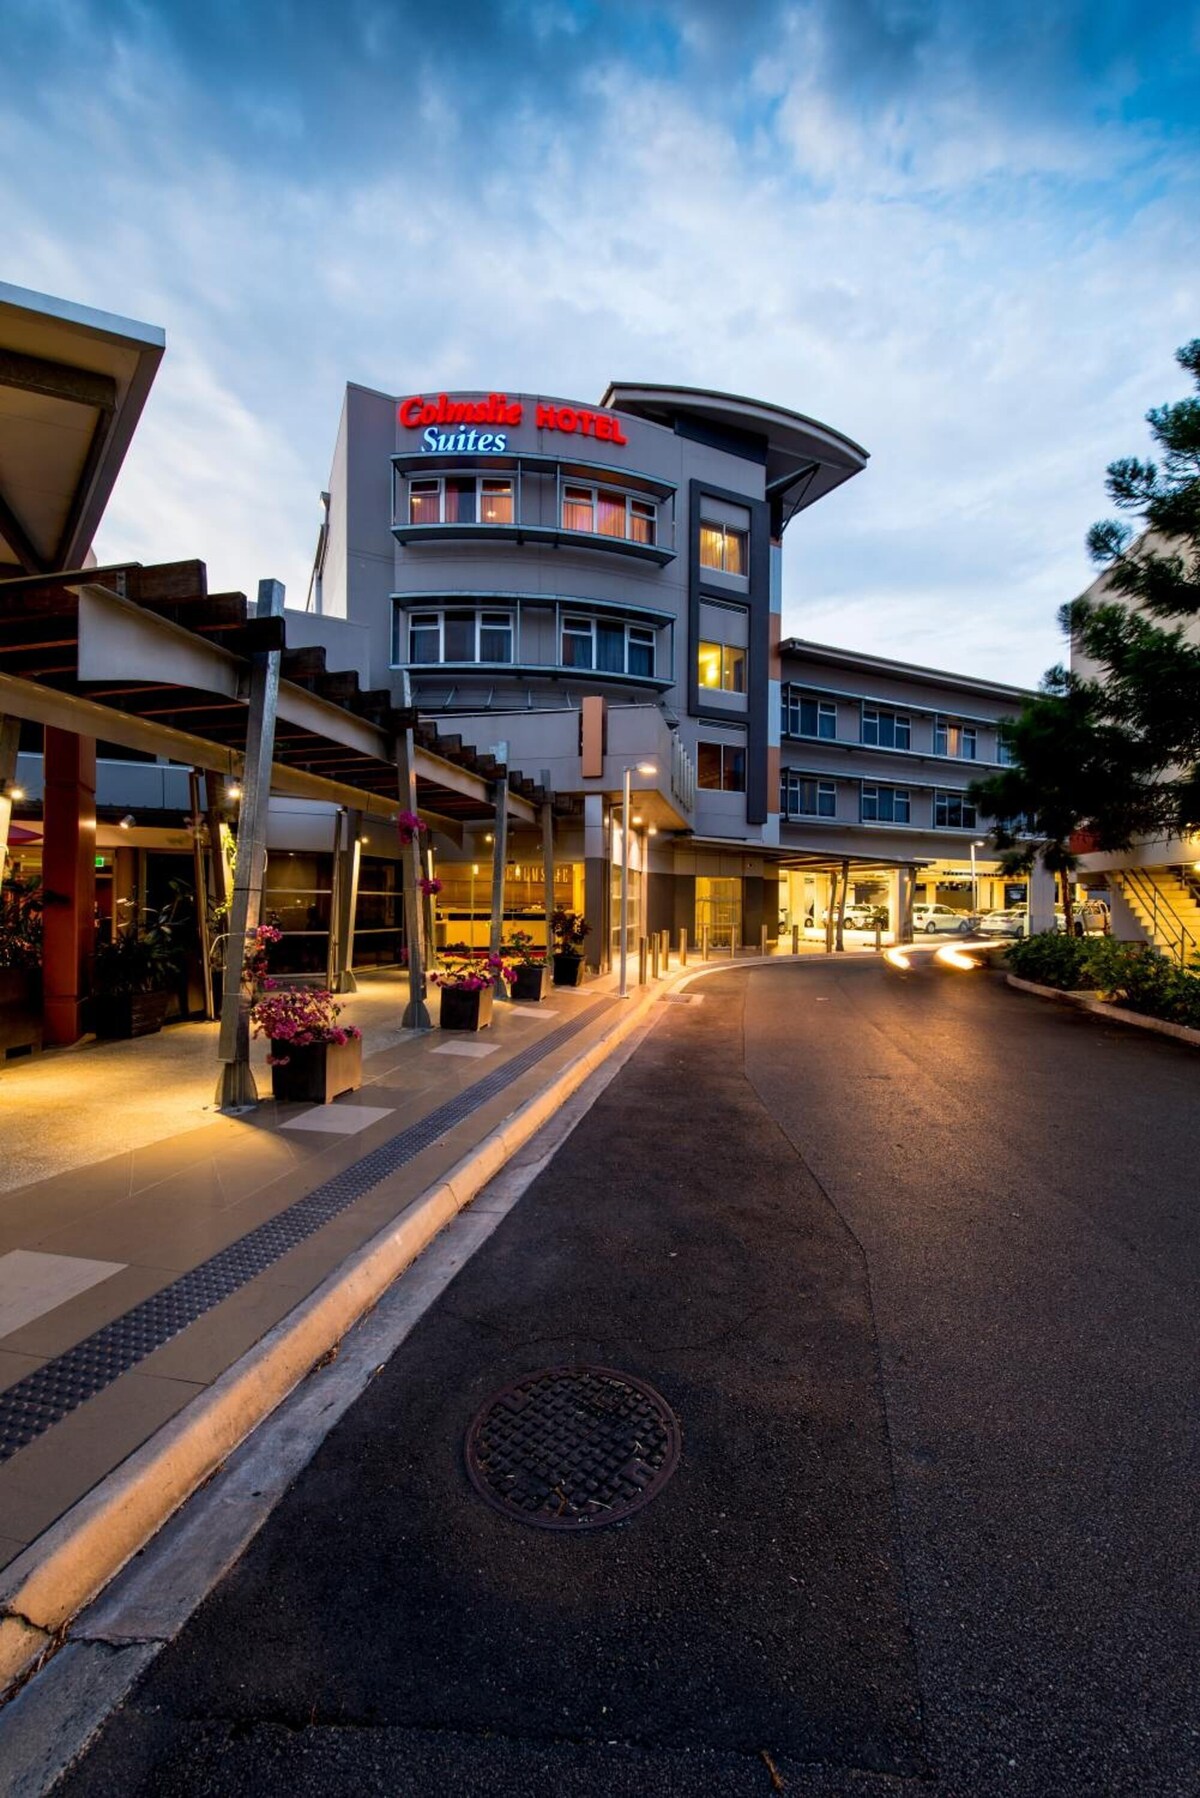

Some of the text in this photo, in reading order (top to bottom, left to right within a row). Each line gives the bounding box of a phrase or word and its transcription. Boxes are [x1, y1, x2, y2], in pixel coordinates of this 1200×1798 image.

[399, 392, 629, 446] Colmslie HOTEL
[421, 424, 507, 452] Suites
[506, 866, 568, 883] CLMSIE
